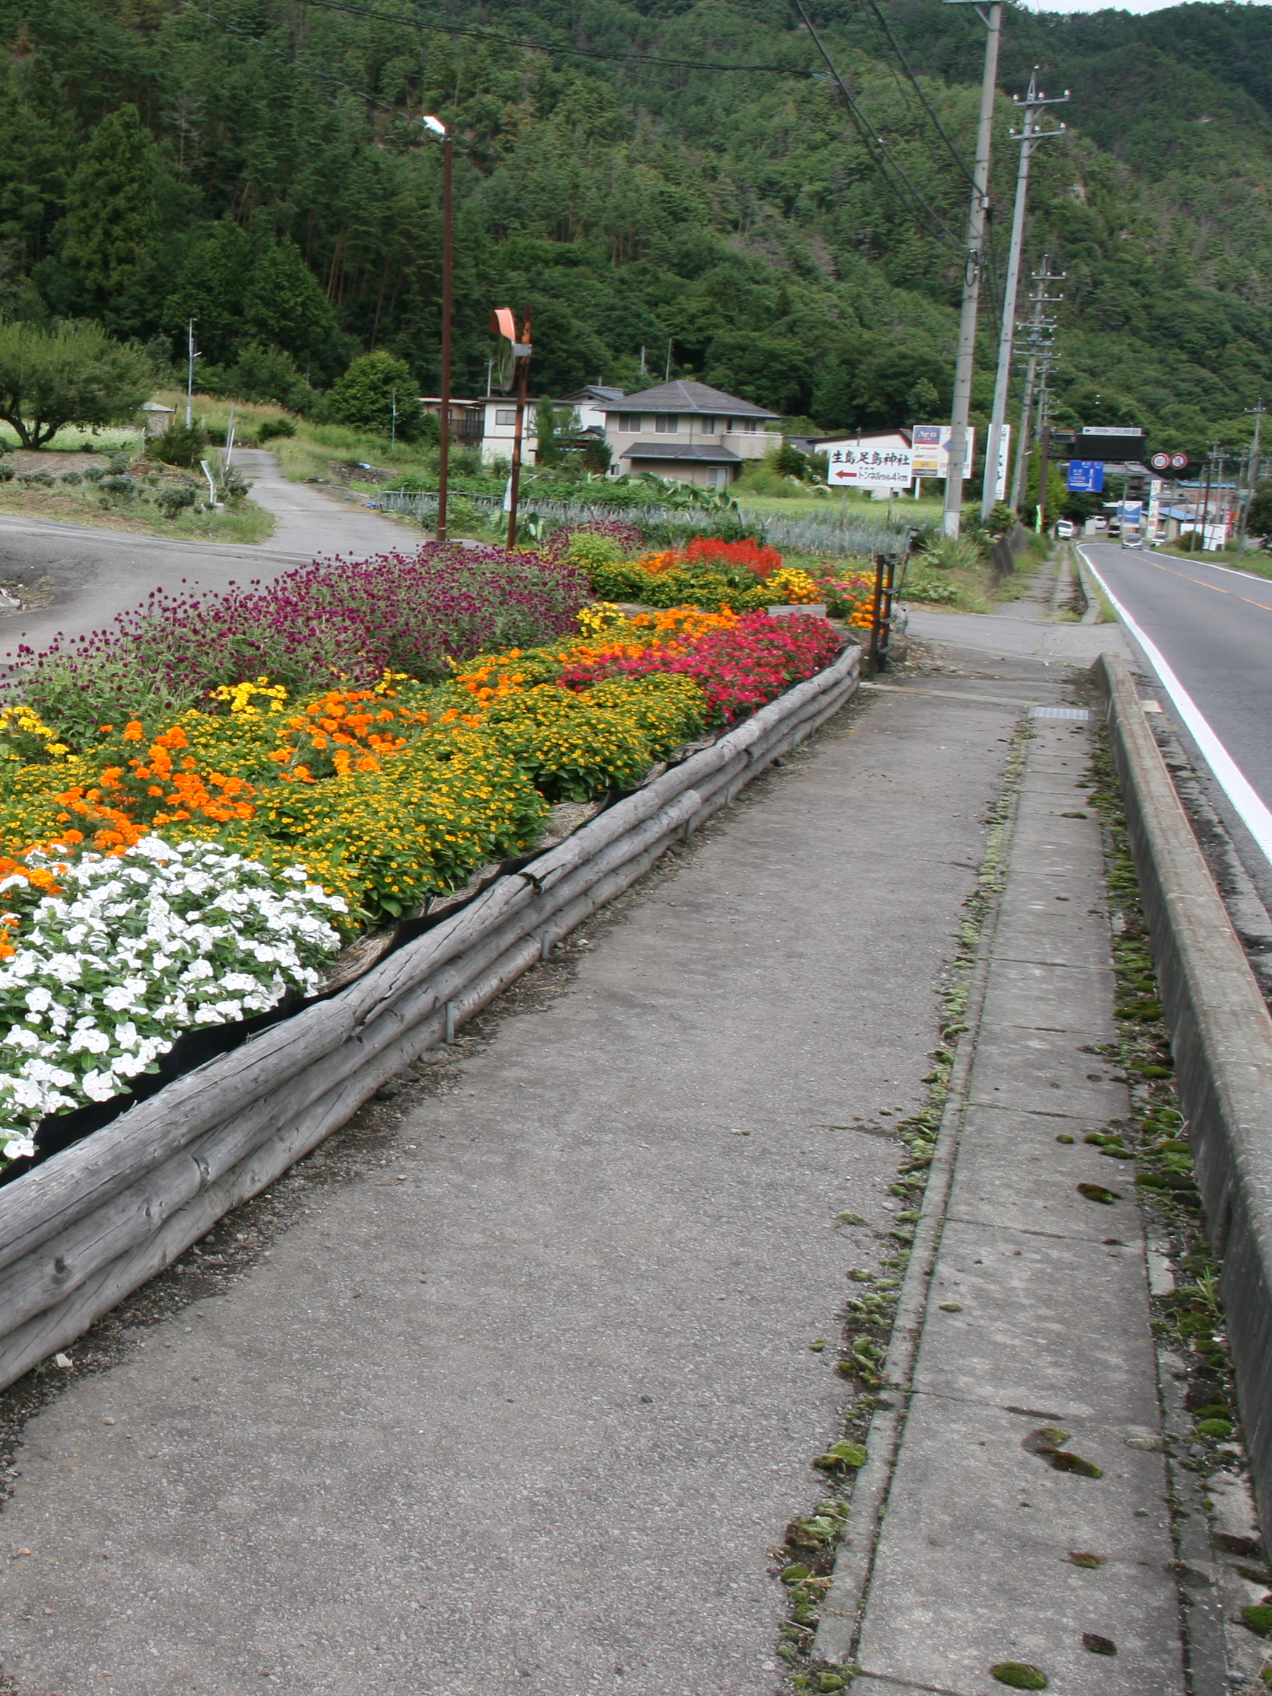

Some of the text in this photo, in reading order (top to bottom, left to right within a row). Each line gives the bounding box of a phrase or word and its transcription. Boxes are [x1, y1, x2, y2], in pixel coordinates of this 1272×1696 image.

[831, 450, 911, 467] 生島足島神社
